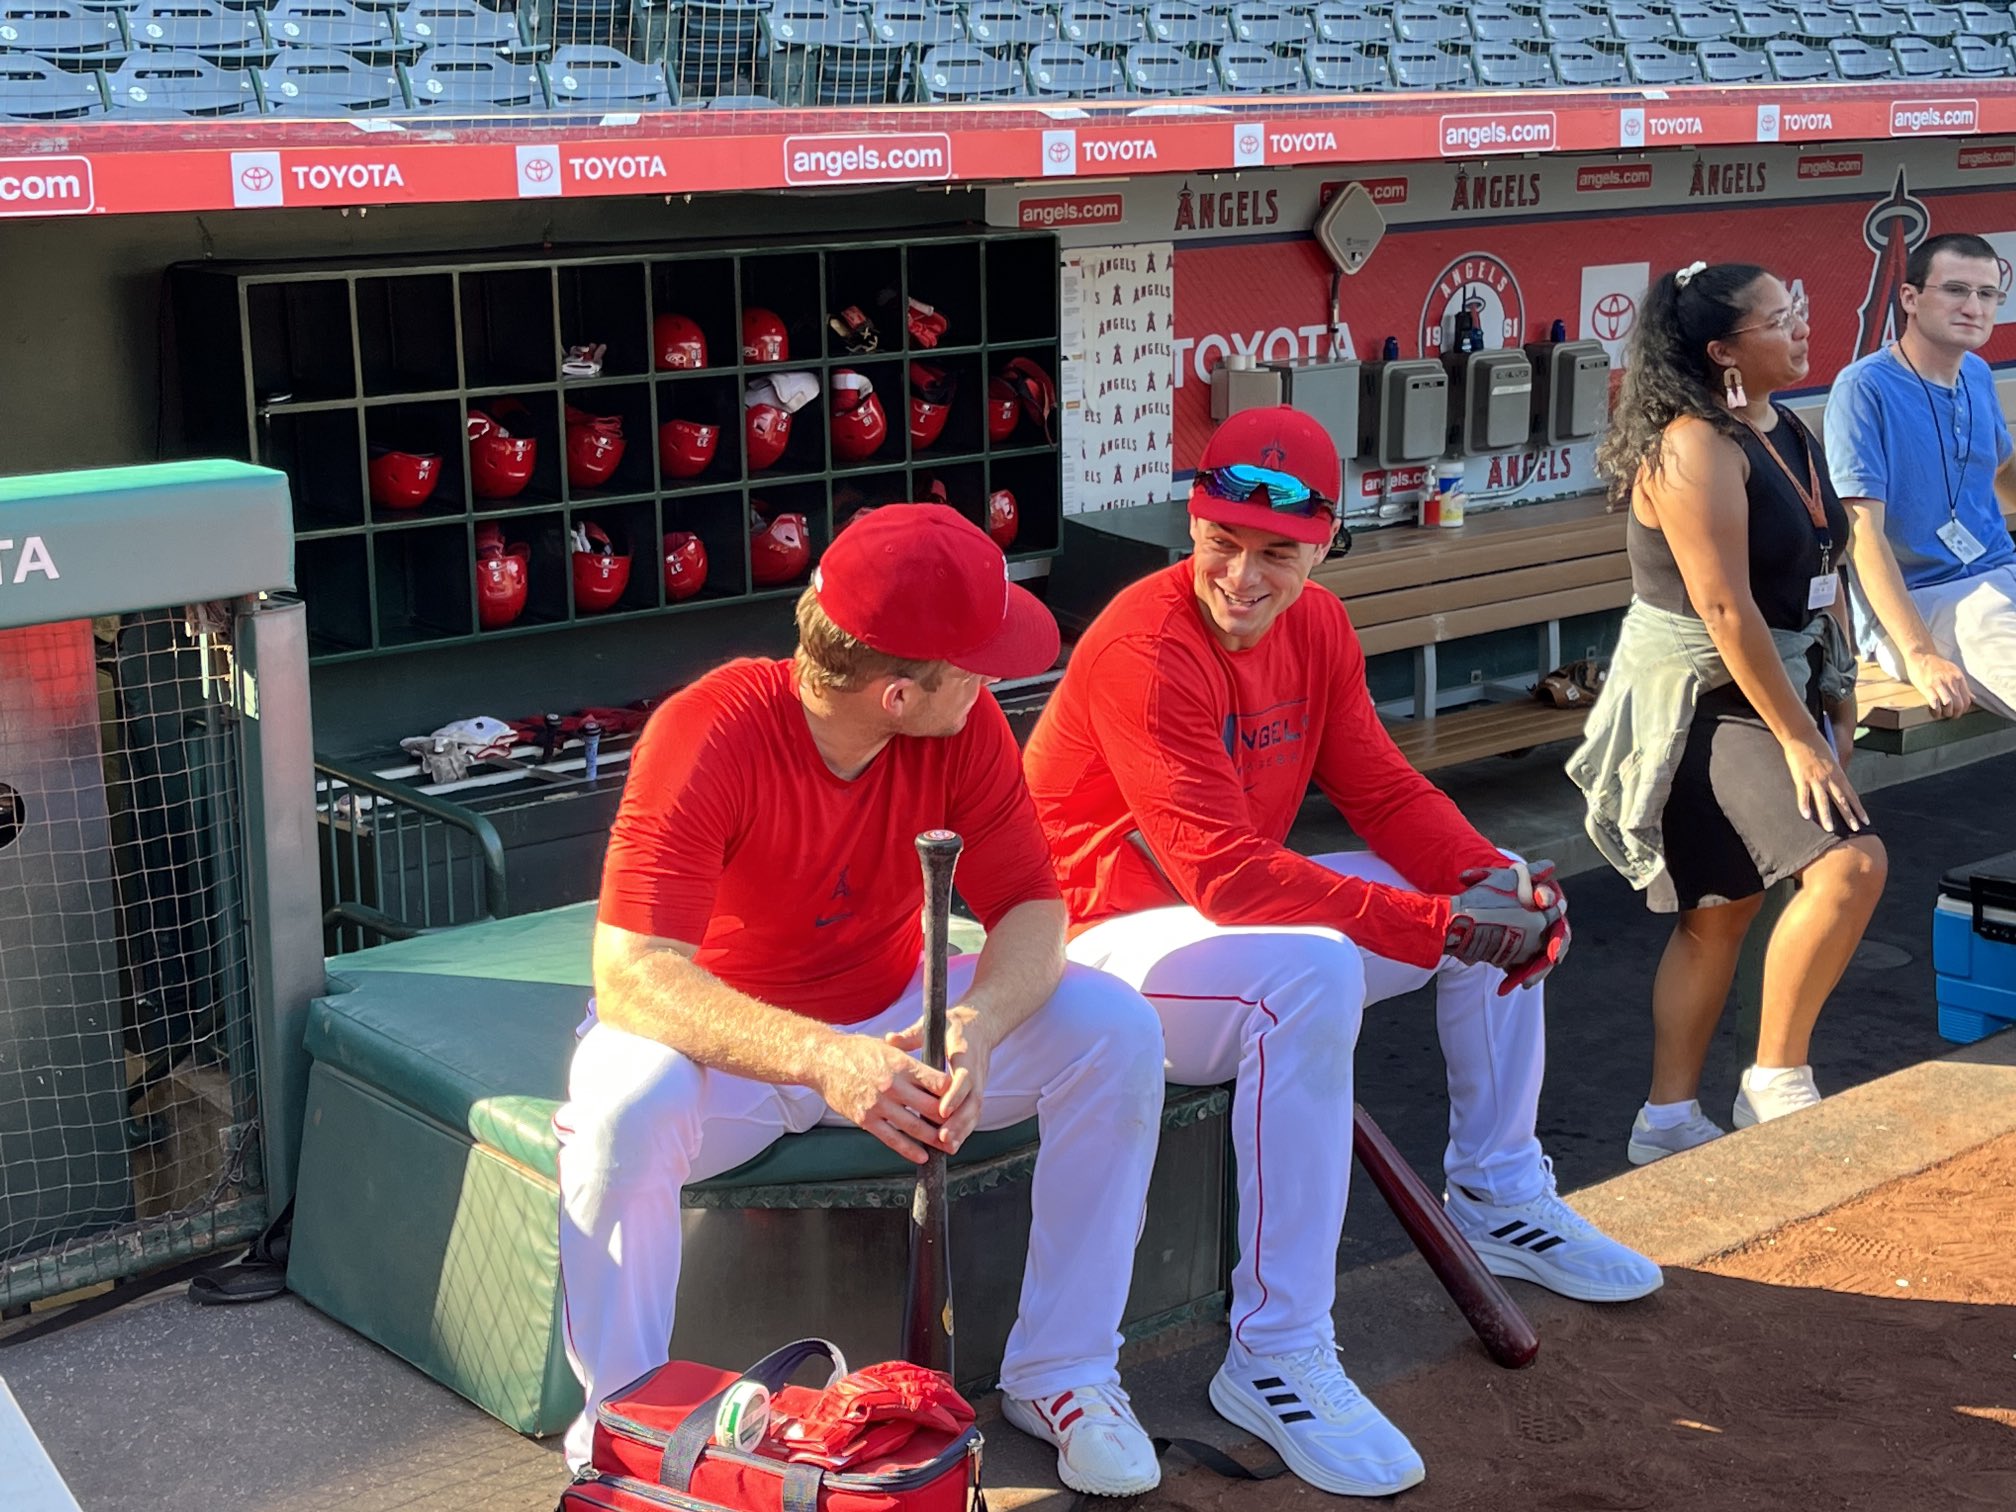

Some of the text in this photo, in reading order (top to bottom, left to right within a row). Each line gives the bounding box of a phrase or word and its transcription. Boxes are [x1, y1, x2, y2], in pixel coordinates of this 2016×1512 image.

[1649, 117, 1703, 136] TOYOTA
[1784, 113, 1833, 131] TOYOTA
[1895, 107, 1974, 131] angels.com
[1269, 132, 1338, 154] TOYOTA
[1445, 121, 1550, 149] angels.com
[793, 144, 943, 178] angels.com
[1082, 139, 1158, 162] TOYOTA
[1959, 150, 2014, 168] angels.com
[291, 163, 404, 191] TOYOTA
[568, 154, 668, 181] TOYOTA
[1578, 167, 1650, 191] angels.com
[1689, 156, 1766, 197] ANGELS
[1799, 157, 1861, 177] angels.com
[1452, 166, 1541, 211] ANGELS
[1022, 200, 1119, 228] angels.com
[1174, 182, 1279, 231] ANGELS
[1440, 261, 1508, 299] ANGELS
[1426, 326, 1442, 347] 19
[1503, 317, 1518, 338] 61
[1486, 447, 1571, 490] ANGELS
